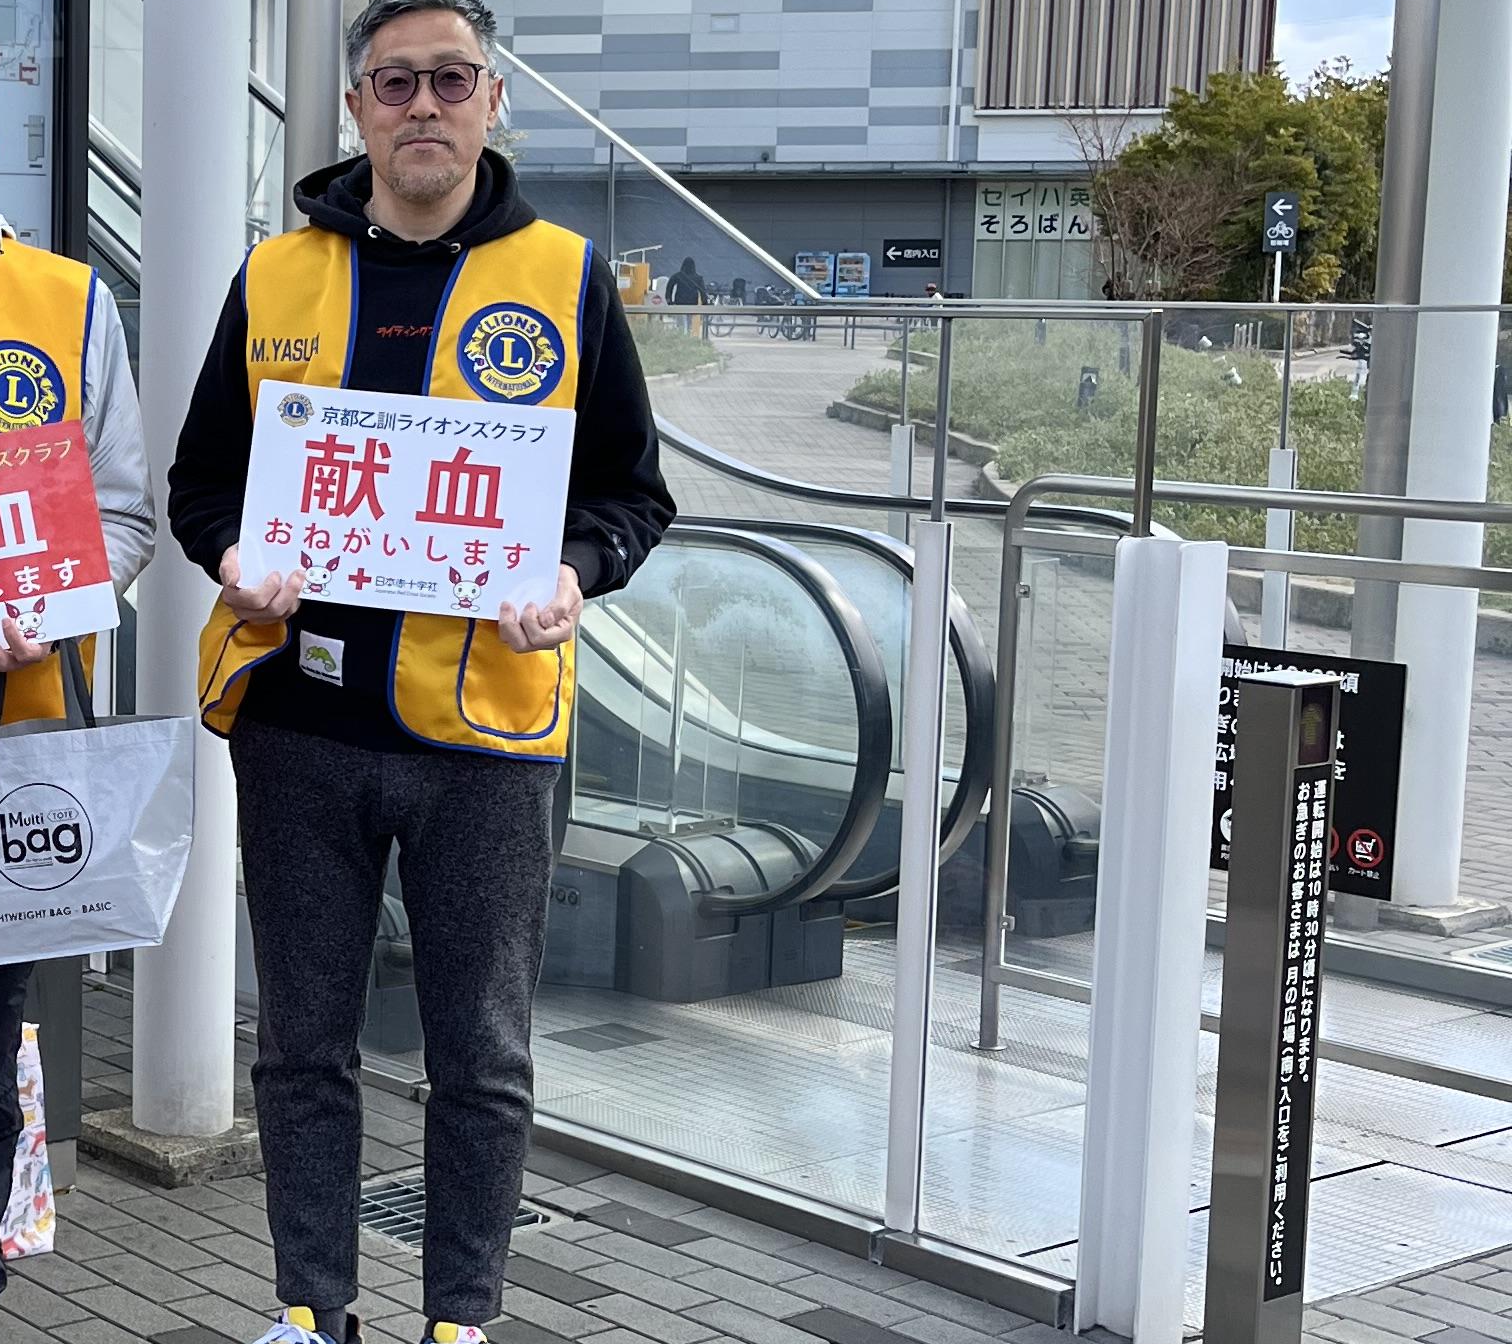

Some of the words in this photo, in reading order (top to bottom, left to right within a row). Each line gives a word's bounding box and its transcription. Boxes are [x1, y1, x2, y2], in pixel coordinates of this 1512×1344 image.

[980, 214, 1089, 234] そろばん
[484, 313, 539, 335] LIONS
[499, 337, 524, 369] L
[4, 375, 28, 408] L
[321, 405, 548, 443] 京都乙訓ライオンズクラブ
[300, 433, 504, 529] 献血
[264, 517, 531, 569] おねがいします
[8, 812, 44, 828] Multi
[53, 810, 73, 819] TOTE
[0, 813, 83, 864] bag
[49, 906, 72, 917] BAG
